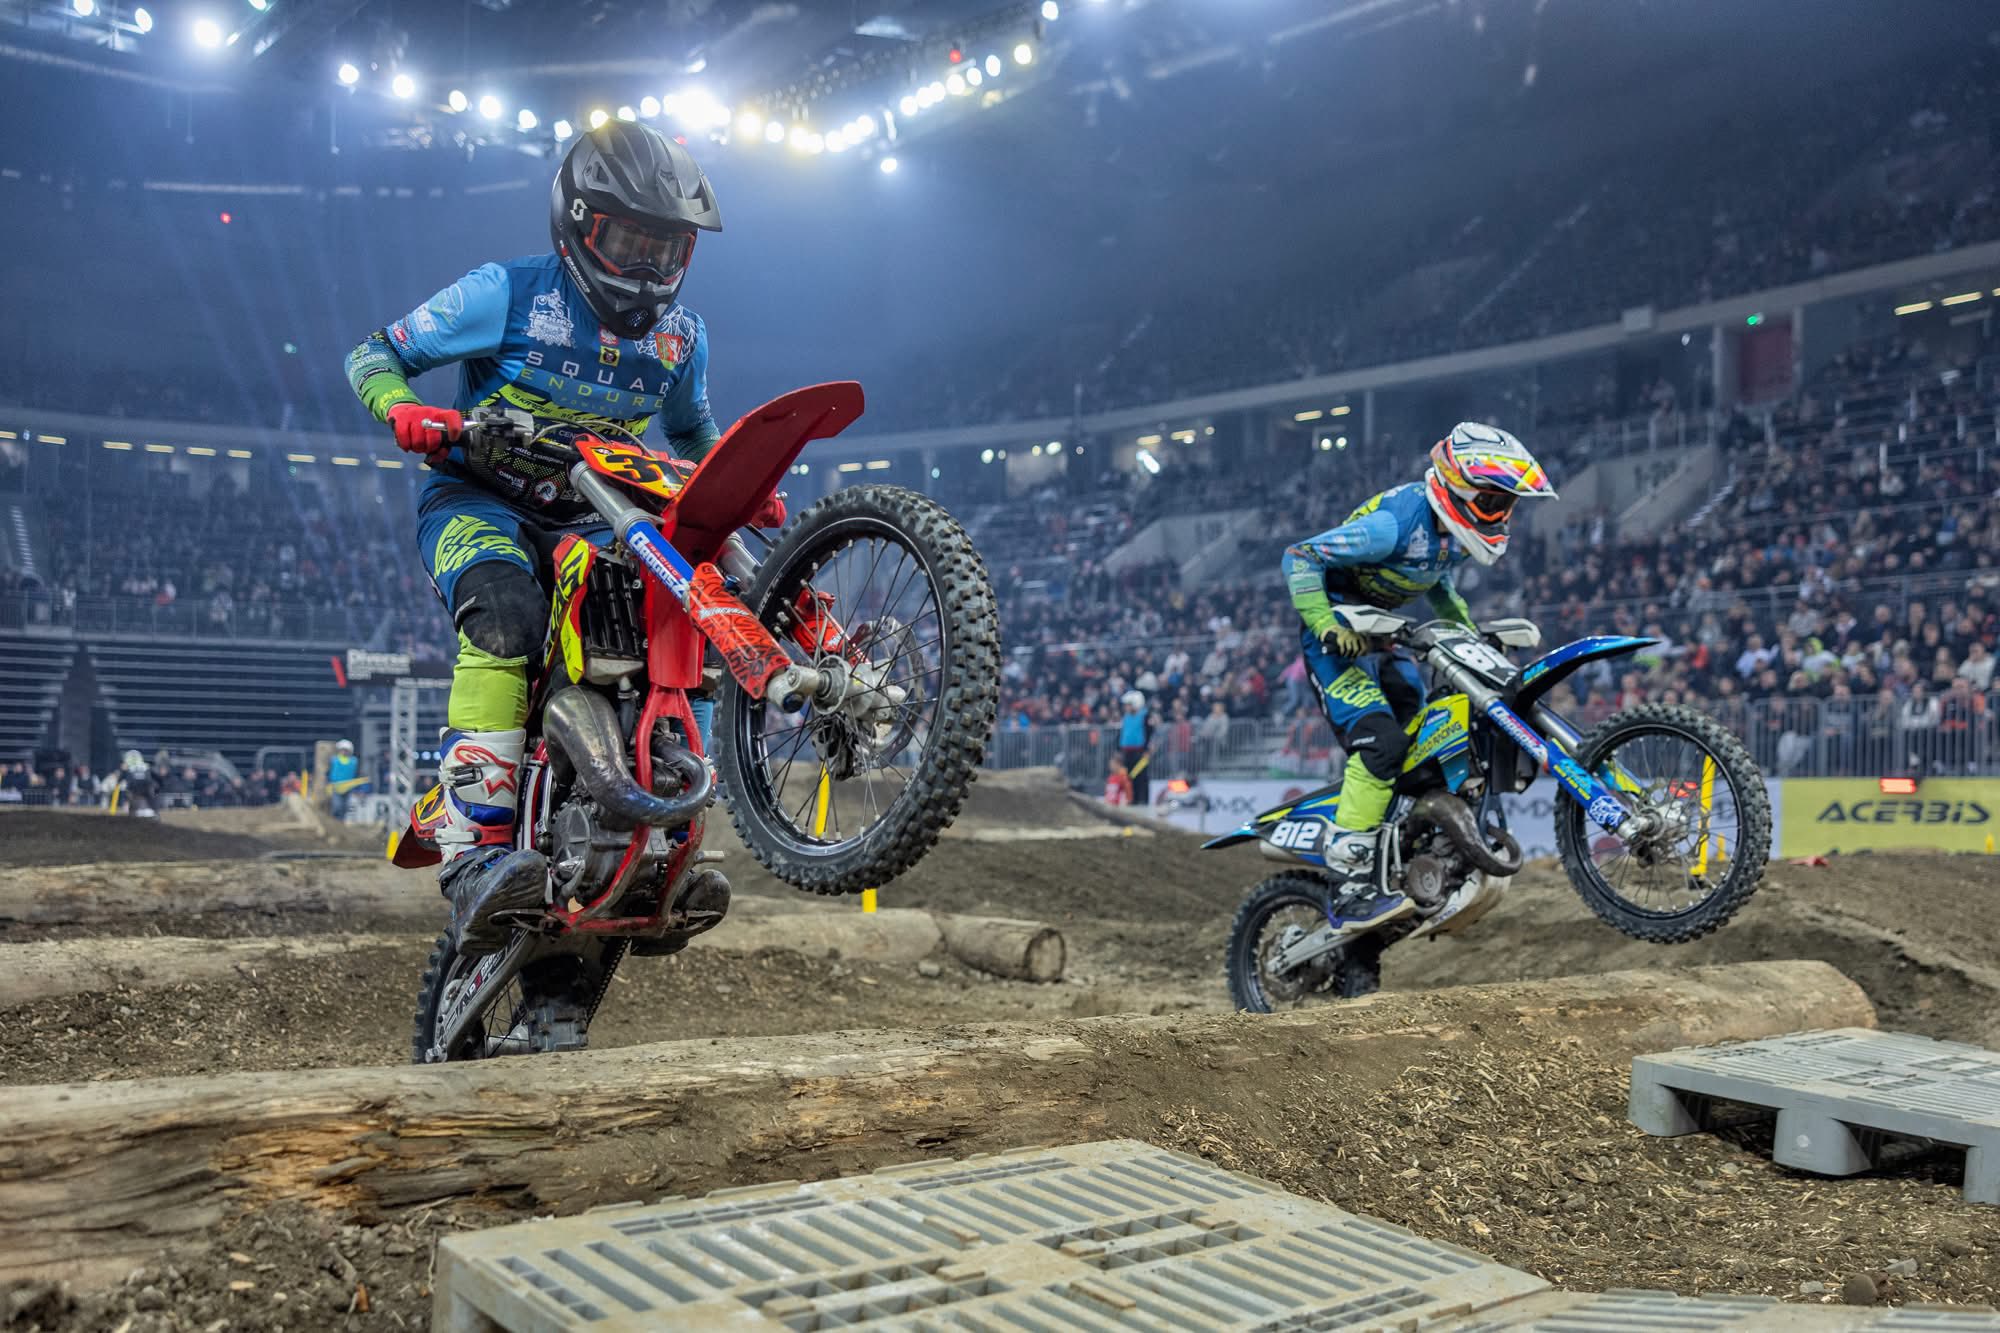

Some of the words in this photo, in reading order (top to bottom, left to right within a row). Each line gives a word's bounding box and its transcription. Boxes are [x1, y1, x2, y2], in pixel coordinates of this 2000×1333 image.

[629, 531, 691, 600] DROGOSZ
[648, 543, 681, 578] RACING
[1269, 821, 1322, 850] 812
